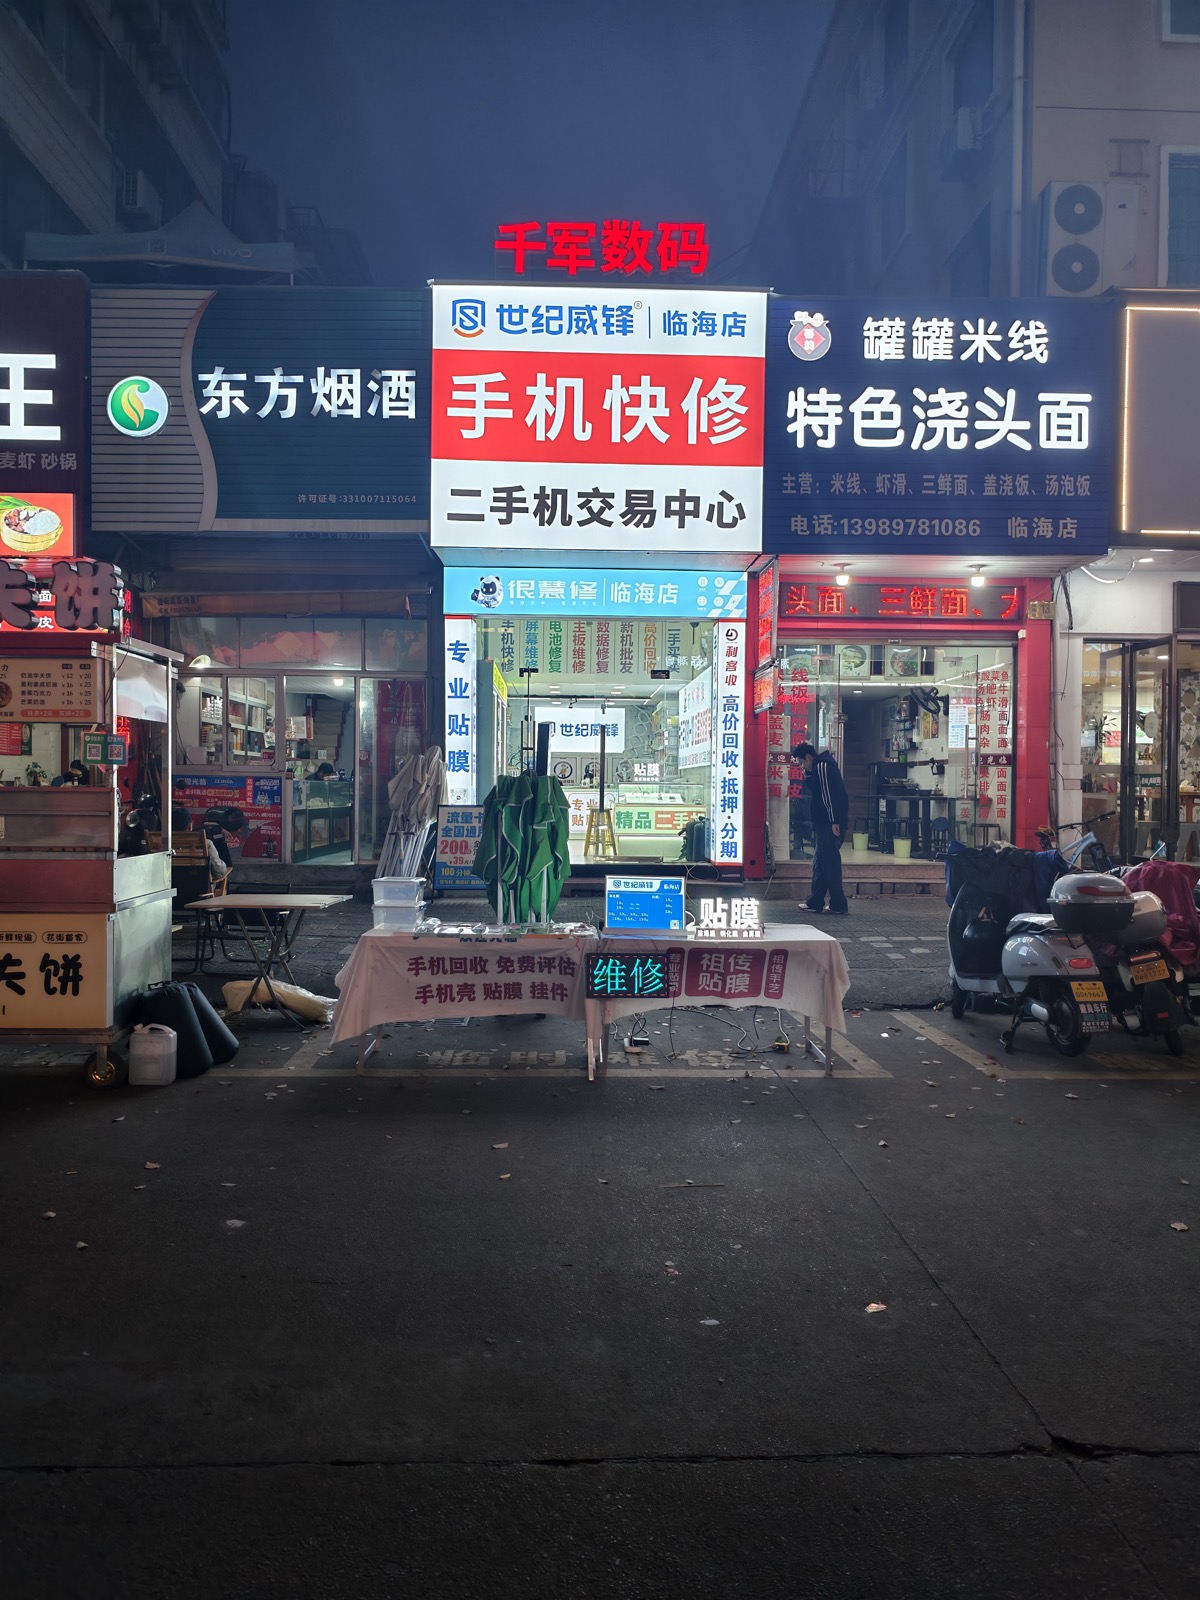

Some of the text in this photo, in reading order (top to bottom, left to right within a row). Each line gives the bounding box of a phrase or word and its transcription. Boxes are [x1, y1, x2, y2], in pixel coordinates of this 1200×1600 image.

[494, 219, 709, 275] 千军数码
[495, 303, 747, 337] 世纪威锋 临海店
[862, 316, 1049, 364] 罐罐米线
[198, 366, 417, 420] 东方烟酒
[446, 371, 749, 445] 手机快修
[786, 386, 1092, 451] 特色浇头面
[41, 452, 77, 470] 砂锅
[447, 485, 746, 529] 二手机交易中心
[790, 514, 1078, 539] 电话:13989781086 临海店
[507, 580, 598, 600] 很慧修
[610, 582, 679, 605] 临海店
[549, 621, 563, 673] 电池修复
[572, 621, 586, 674] 主板维修
[596, 621, 610, 674] 数据修复
[619, 622, 634, 674] 新机批发
[447, 640, 470, 773] 专业贴膜
[634, 762, 660, 776] 贴膜
[616, 811, 651, 829] 精品
[700, 897, 760, 930] 贴膜
[407, 956, 575, 977] 手机回收 免费评估
[593, 958, 664, 994] 维修
[702, 953, 752, 972] 祖传
[768, 954, 784, 993] 祖传手艺
[415, 982, 569, 1004] 手机壳 贴膜 挂件
[698, 973, 749, 993] 贴膜
